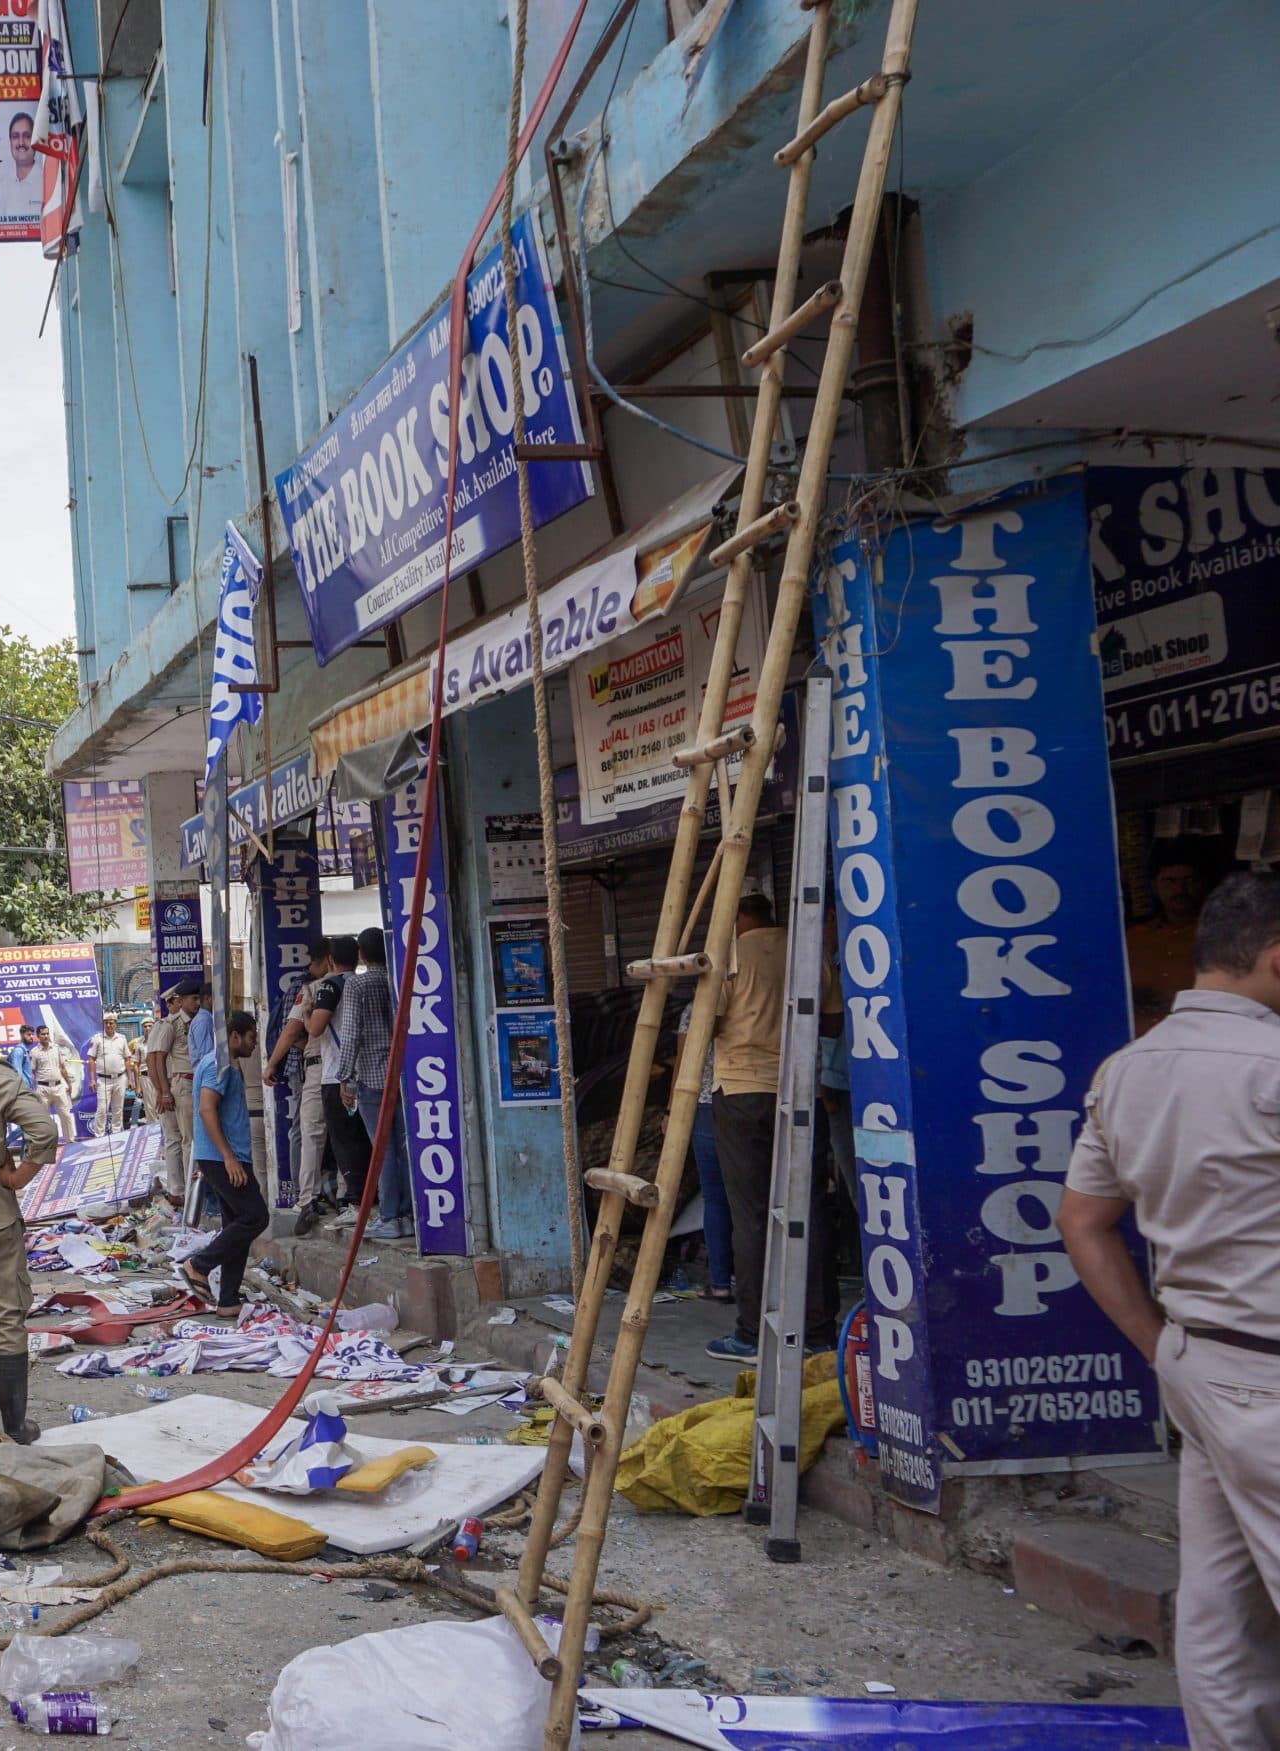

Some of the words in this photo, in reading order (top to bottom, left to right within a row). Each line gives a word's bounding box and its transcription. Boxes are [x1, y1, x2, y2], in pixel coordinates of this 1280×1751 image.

[12, 24, 30, 35] SIR
[292, 484, 348, 594] THE
[340, 406, 433, 554] BOOK
[430, 303, 544, 478] SHOP
[380, 540, 393, 568] All
[393, 504, 445, 557] Competitive
[472, 444, 519, 501] Availabl
[366, 586, 396, 615] Courier
[393, 564, 424, 598] Facility
[1131, 567, 1184, 604] Book
[929, 510, 1040, 701] THE
[468, 586, 622, 696] Avaiable
[609, 635, 683, 685] AMBITION
[817, 558, 871, 760] THE
[1122, 646, 1164, 671] Book
[1166, 632, 1210, 660] Shop
[635, 665, 685, 695] INSTITUTE
[638, 719, 656, 737] IAS
[663, 707, 687, 727] CLAT
[637, 777, 650, 791] DR.
[651, 765, 690, 788] MUKHERJE
[946, 726, 1073, 999] BOOK
[273, 850, 311, 929] THE
[833, 783, 900, 1060] BOOK
[161, 950, 201, 965] CONCEPT
[163, 935, 197, 949] BHARTI
[398, 876, 450, 1036] BOOK
[4, 977, 53, 989] RAILWAY,
[20, 964, 41, 973] ALL
[42, 963, 51, 972] &
[55, 975, 92, 985] DSSSB,
[15, 992, 47, 1002] CHSL,
[49, 991, 73, 1000] SSC,
[75, 989, 99, 998] CET,
[416, 1055, 456, 1229] SHOP
[971, 1040, 1085, 1317] SHOP
[966, 1352, 1123, 1389] 9310262701
[951, 1387, 1142, 1429] 011-27652485
